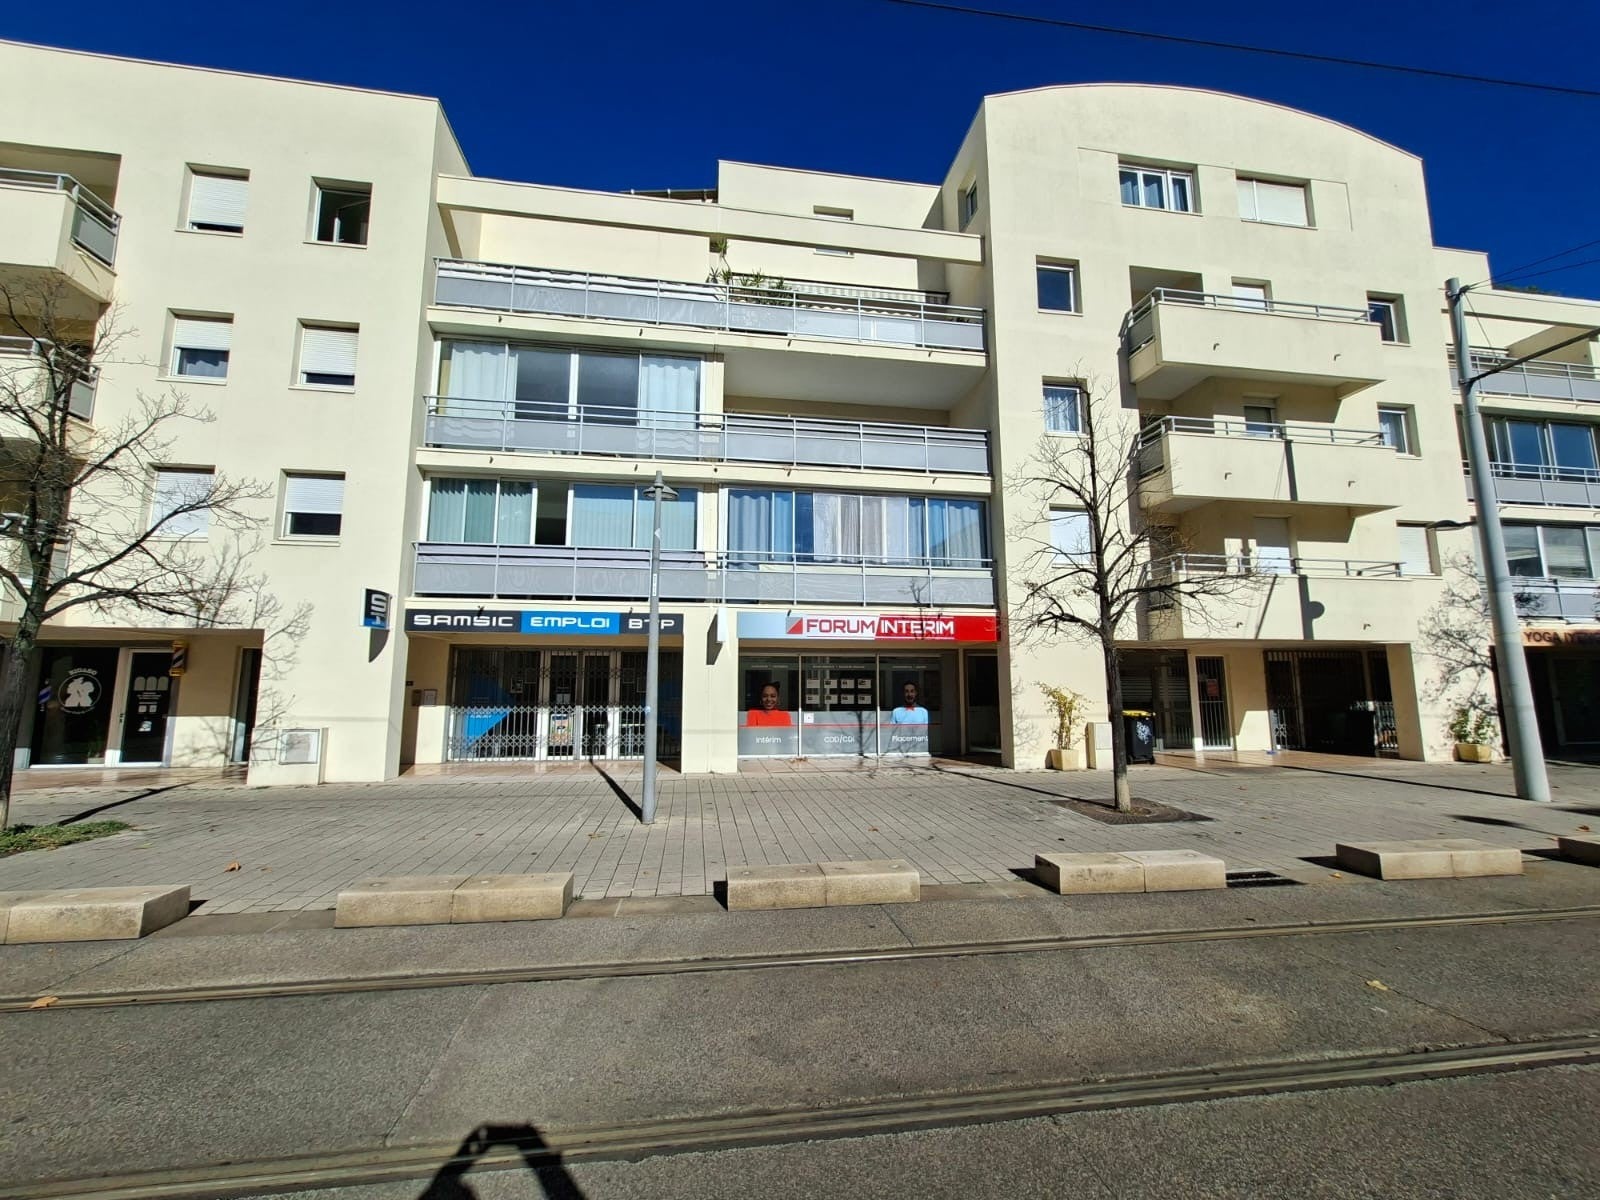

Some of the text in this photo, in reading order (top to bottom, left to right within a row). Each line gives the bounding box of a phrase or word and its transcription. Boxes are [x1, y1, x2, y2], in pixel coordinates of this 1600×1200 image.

[413, 614, 675, 629] SAMSIC EMPLOI BP
[806, 619, 955, 635] FORUM INTERIM
[1523, 631, 1562, 643] YOGA
[823, 734, 855, 744] CDD/CDI
